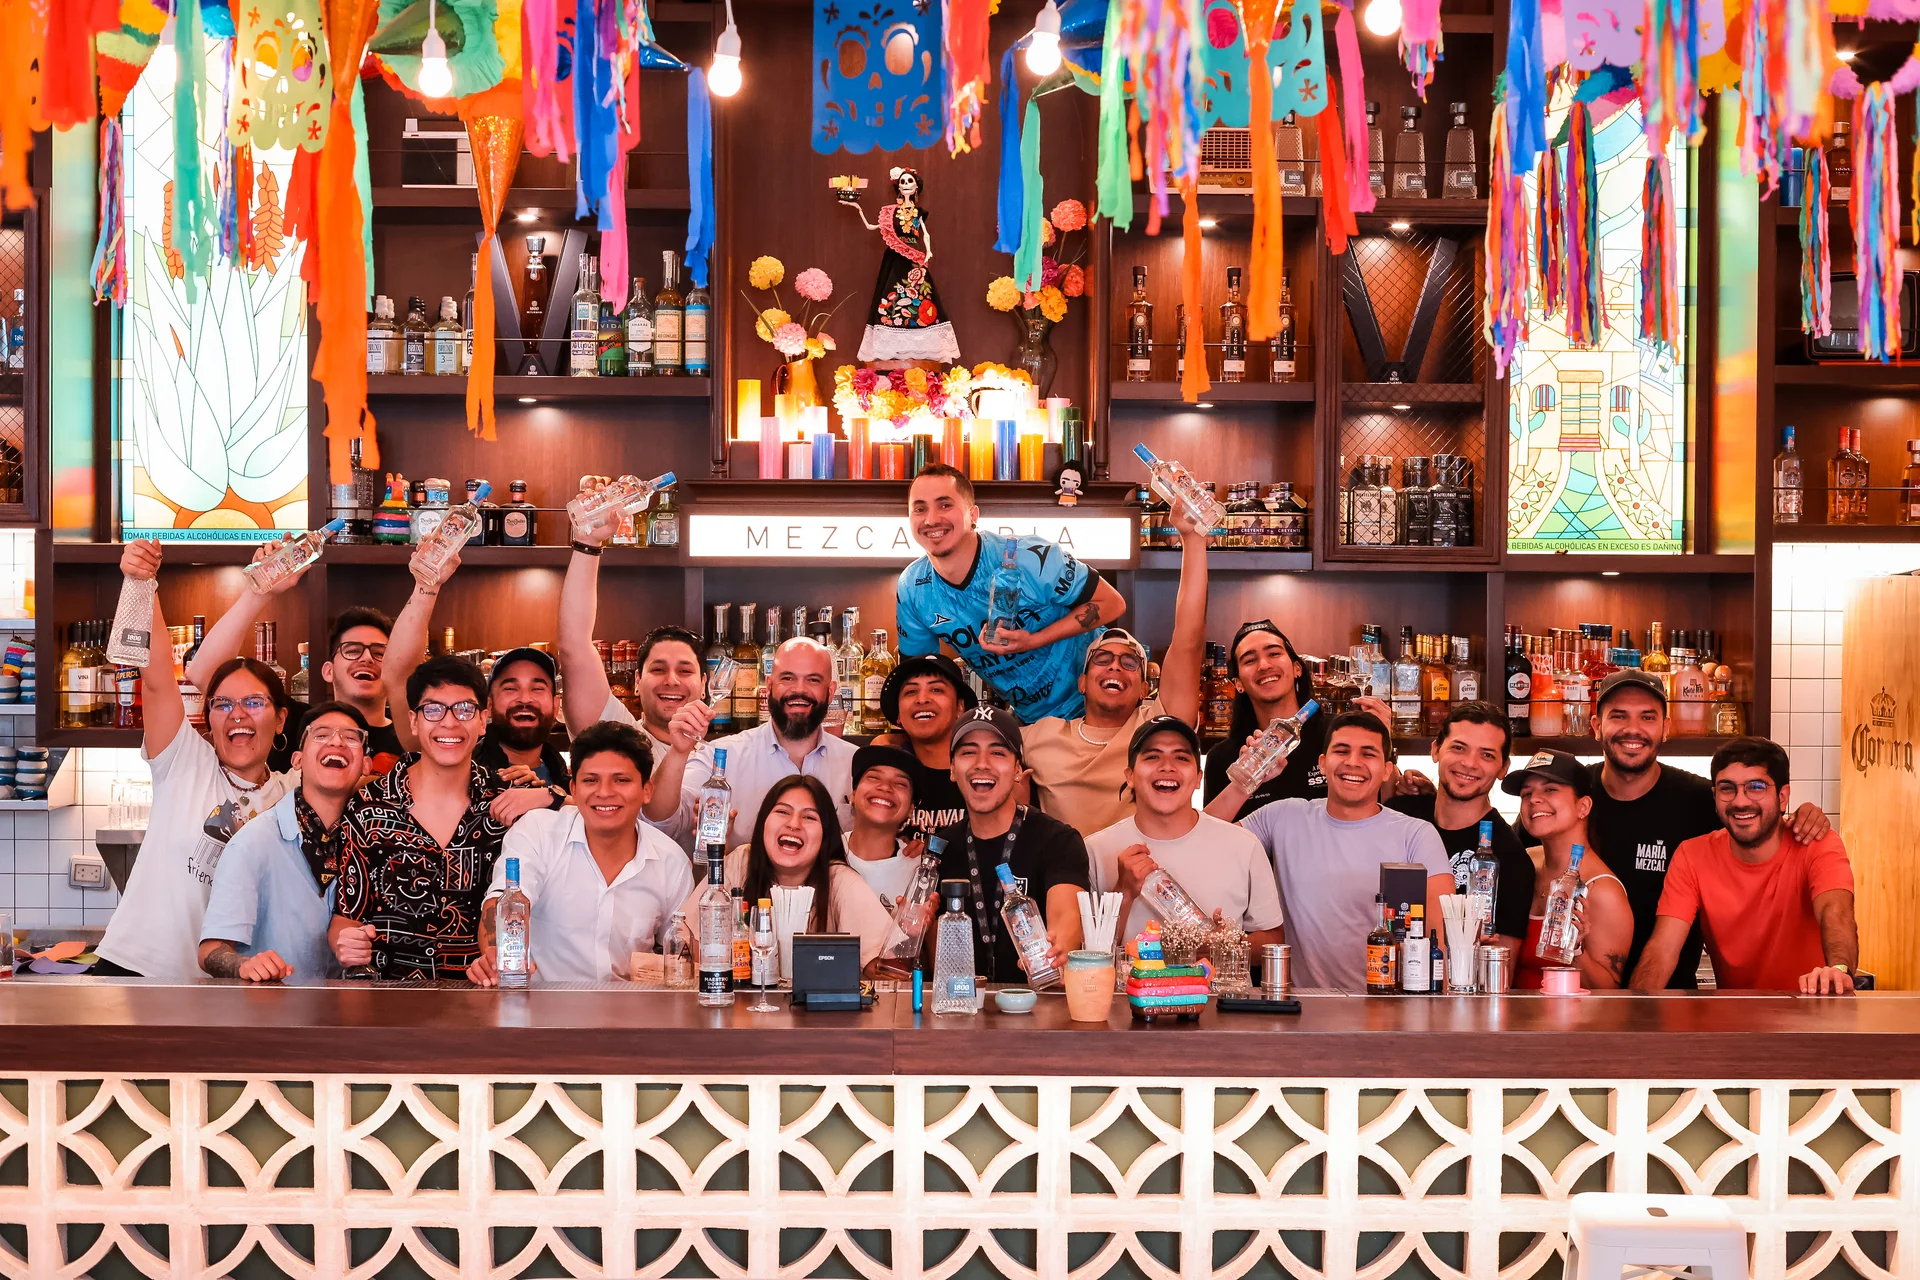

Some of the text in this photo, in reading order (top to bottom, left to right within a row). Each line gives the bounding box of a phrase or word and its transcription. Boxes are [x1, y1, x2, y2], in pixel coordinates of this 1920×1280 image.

[152, 532, 185, 540] BEBIDAS
[187, 530, 239, 540] ALCOHÓLICAS
[240, 532, 252, 540] EN
[253, 532, 283, 540] EXCESO
[1511, 542, 1543, 550] BEBIDAS
[1544, 540, 1596, 550] ALCOHÓLICAS
[1610, 543, 1639, 551] EXCESO
[1641, 543, 1651, 551] ES
[1652, 541, 1682, 551] DAÑINO
[127, 634, 142, 642] 1800
[899, 808, 966, 832] ARNAVAL
[1635, 858, 1666, 872] MEZCAL
